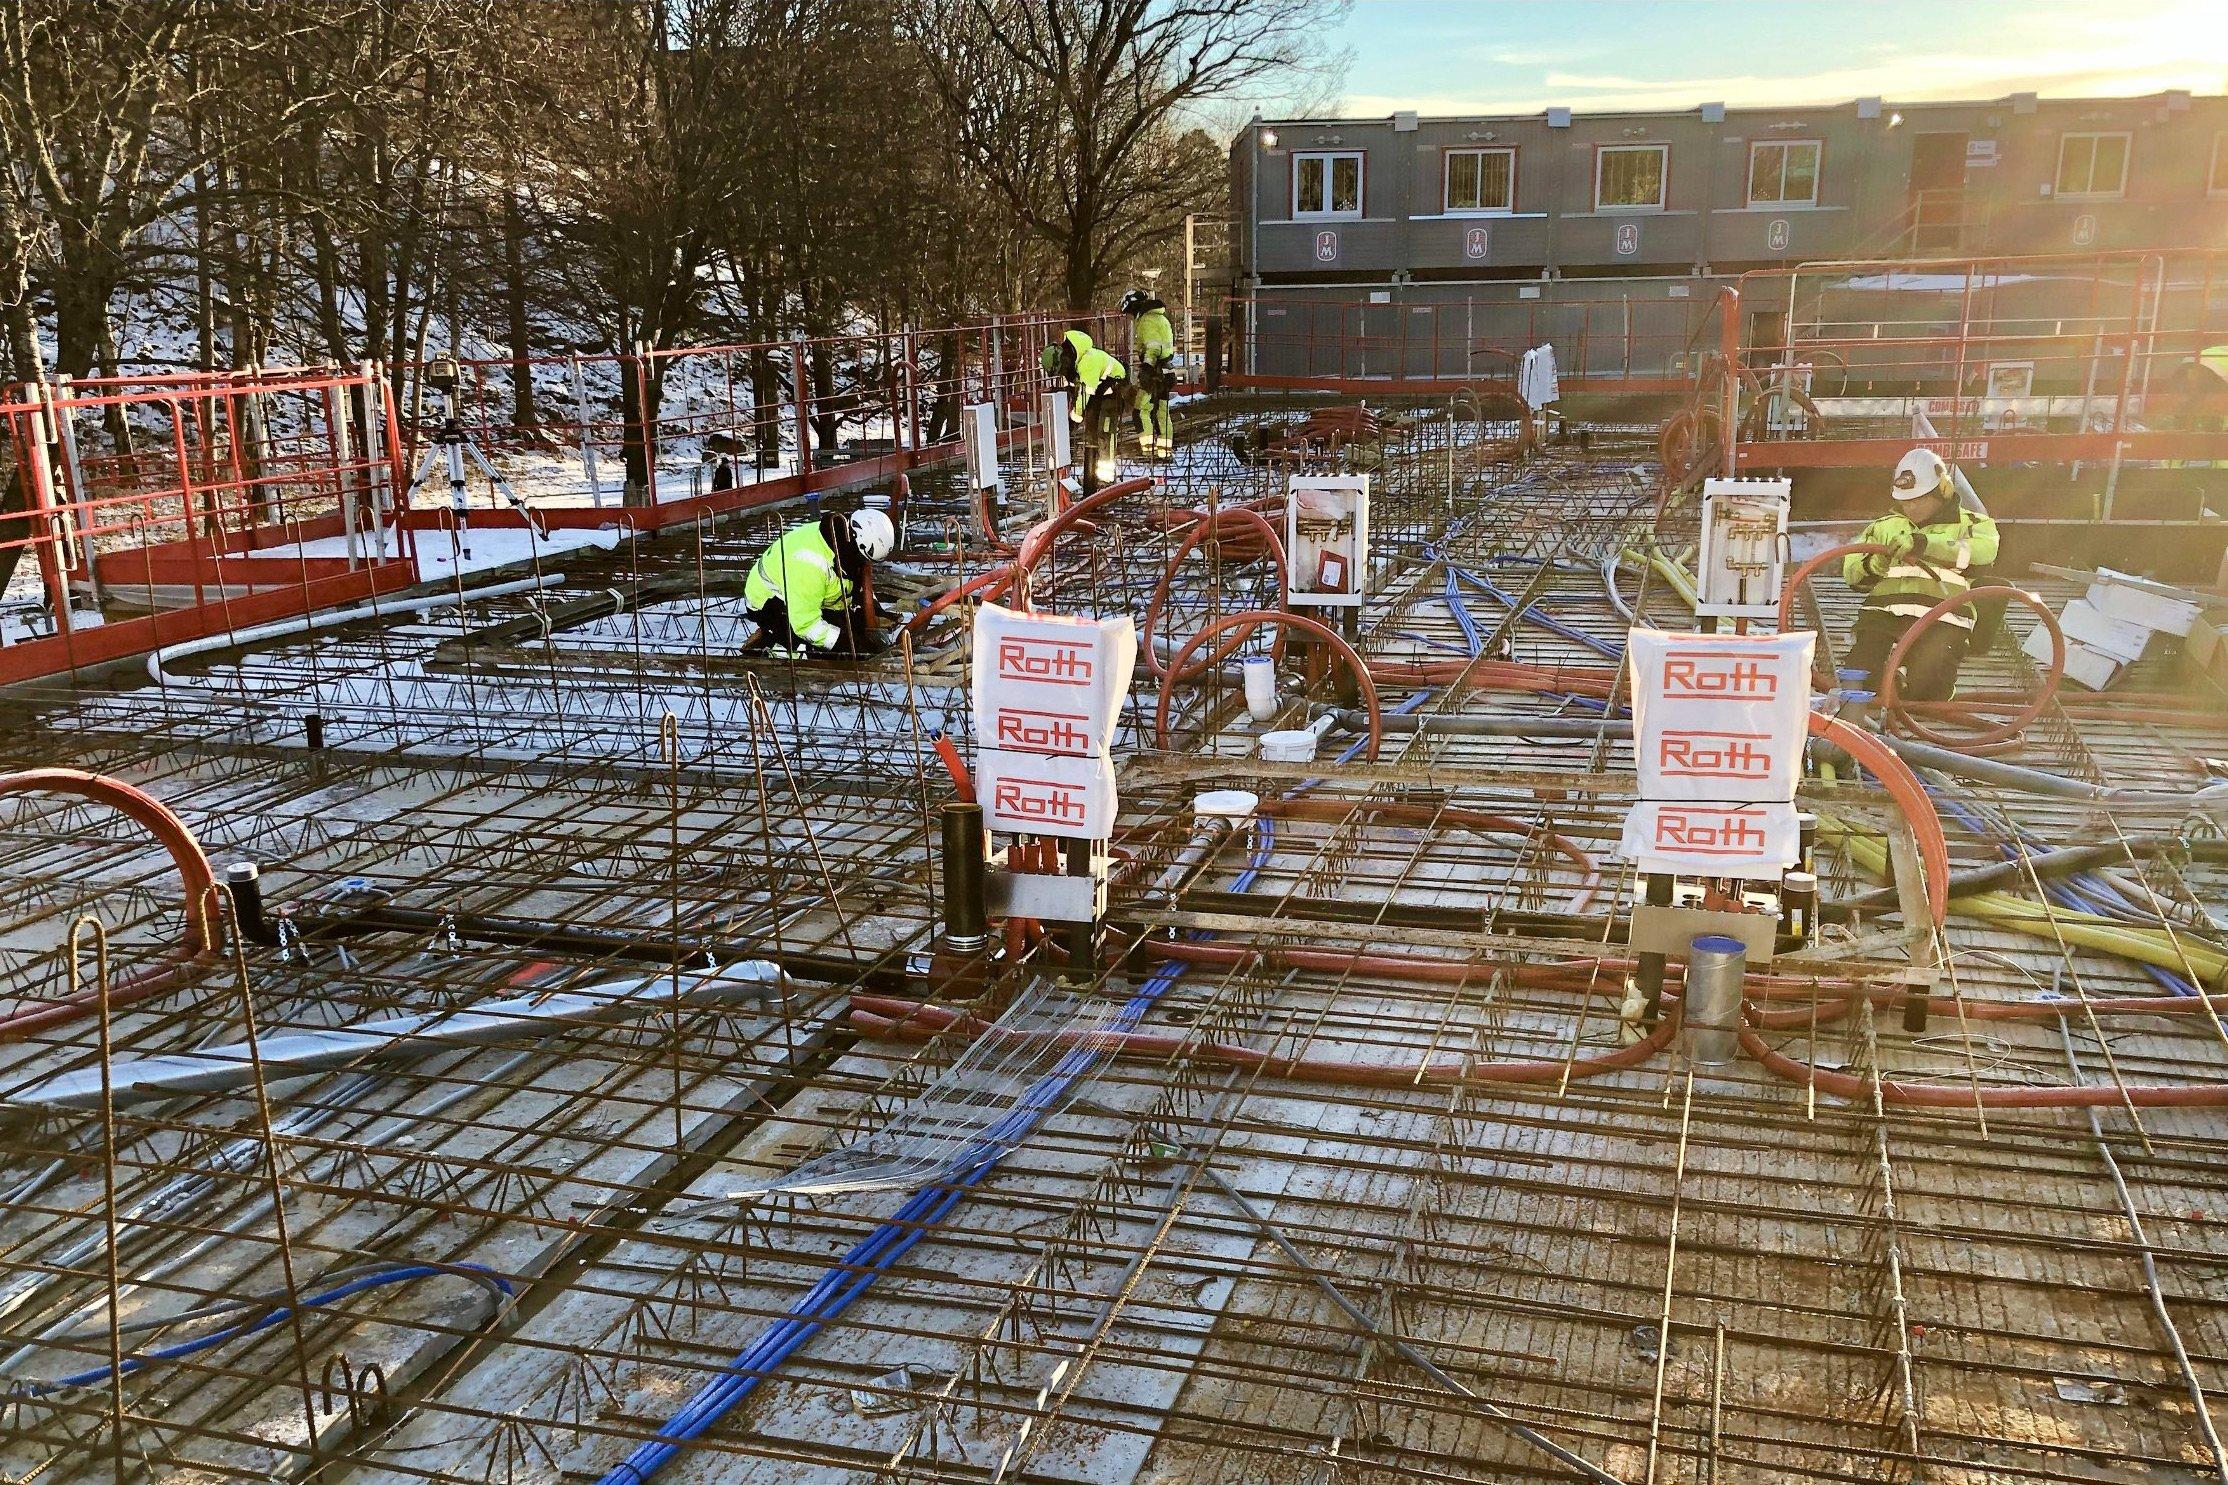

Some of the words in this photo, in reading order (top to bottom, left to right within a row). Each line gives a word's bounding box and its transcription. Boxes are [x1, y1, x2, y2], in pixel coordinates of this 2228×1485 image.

[999, 644, 1092, 677] Roth
[1663, 660, 1777, 693] Roth
[998, 715, 1089, 749] Roth
[1660, 739, 1771, 771] Roth
[995, 784, 1085, 819] Roth
[1656, 815, 1765, 847] Roth
